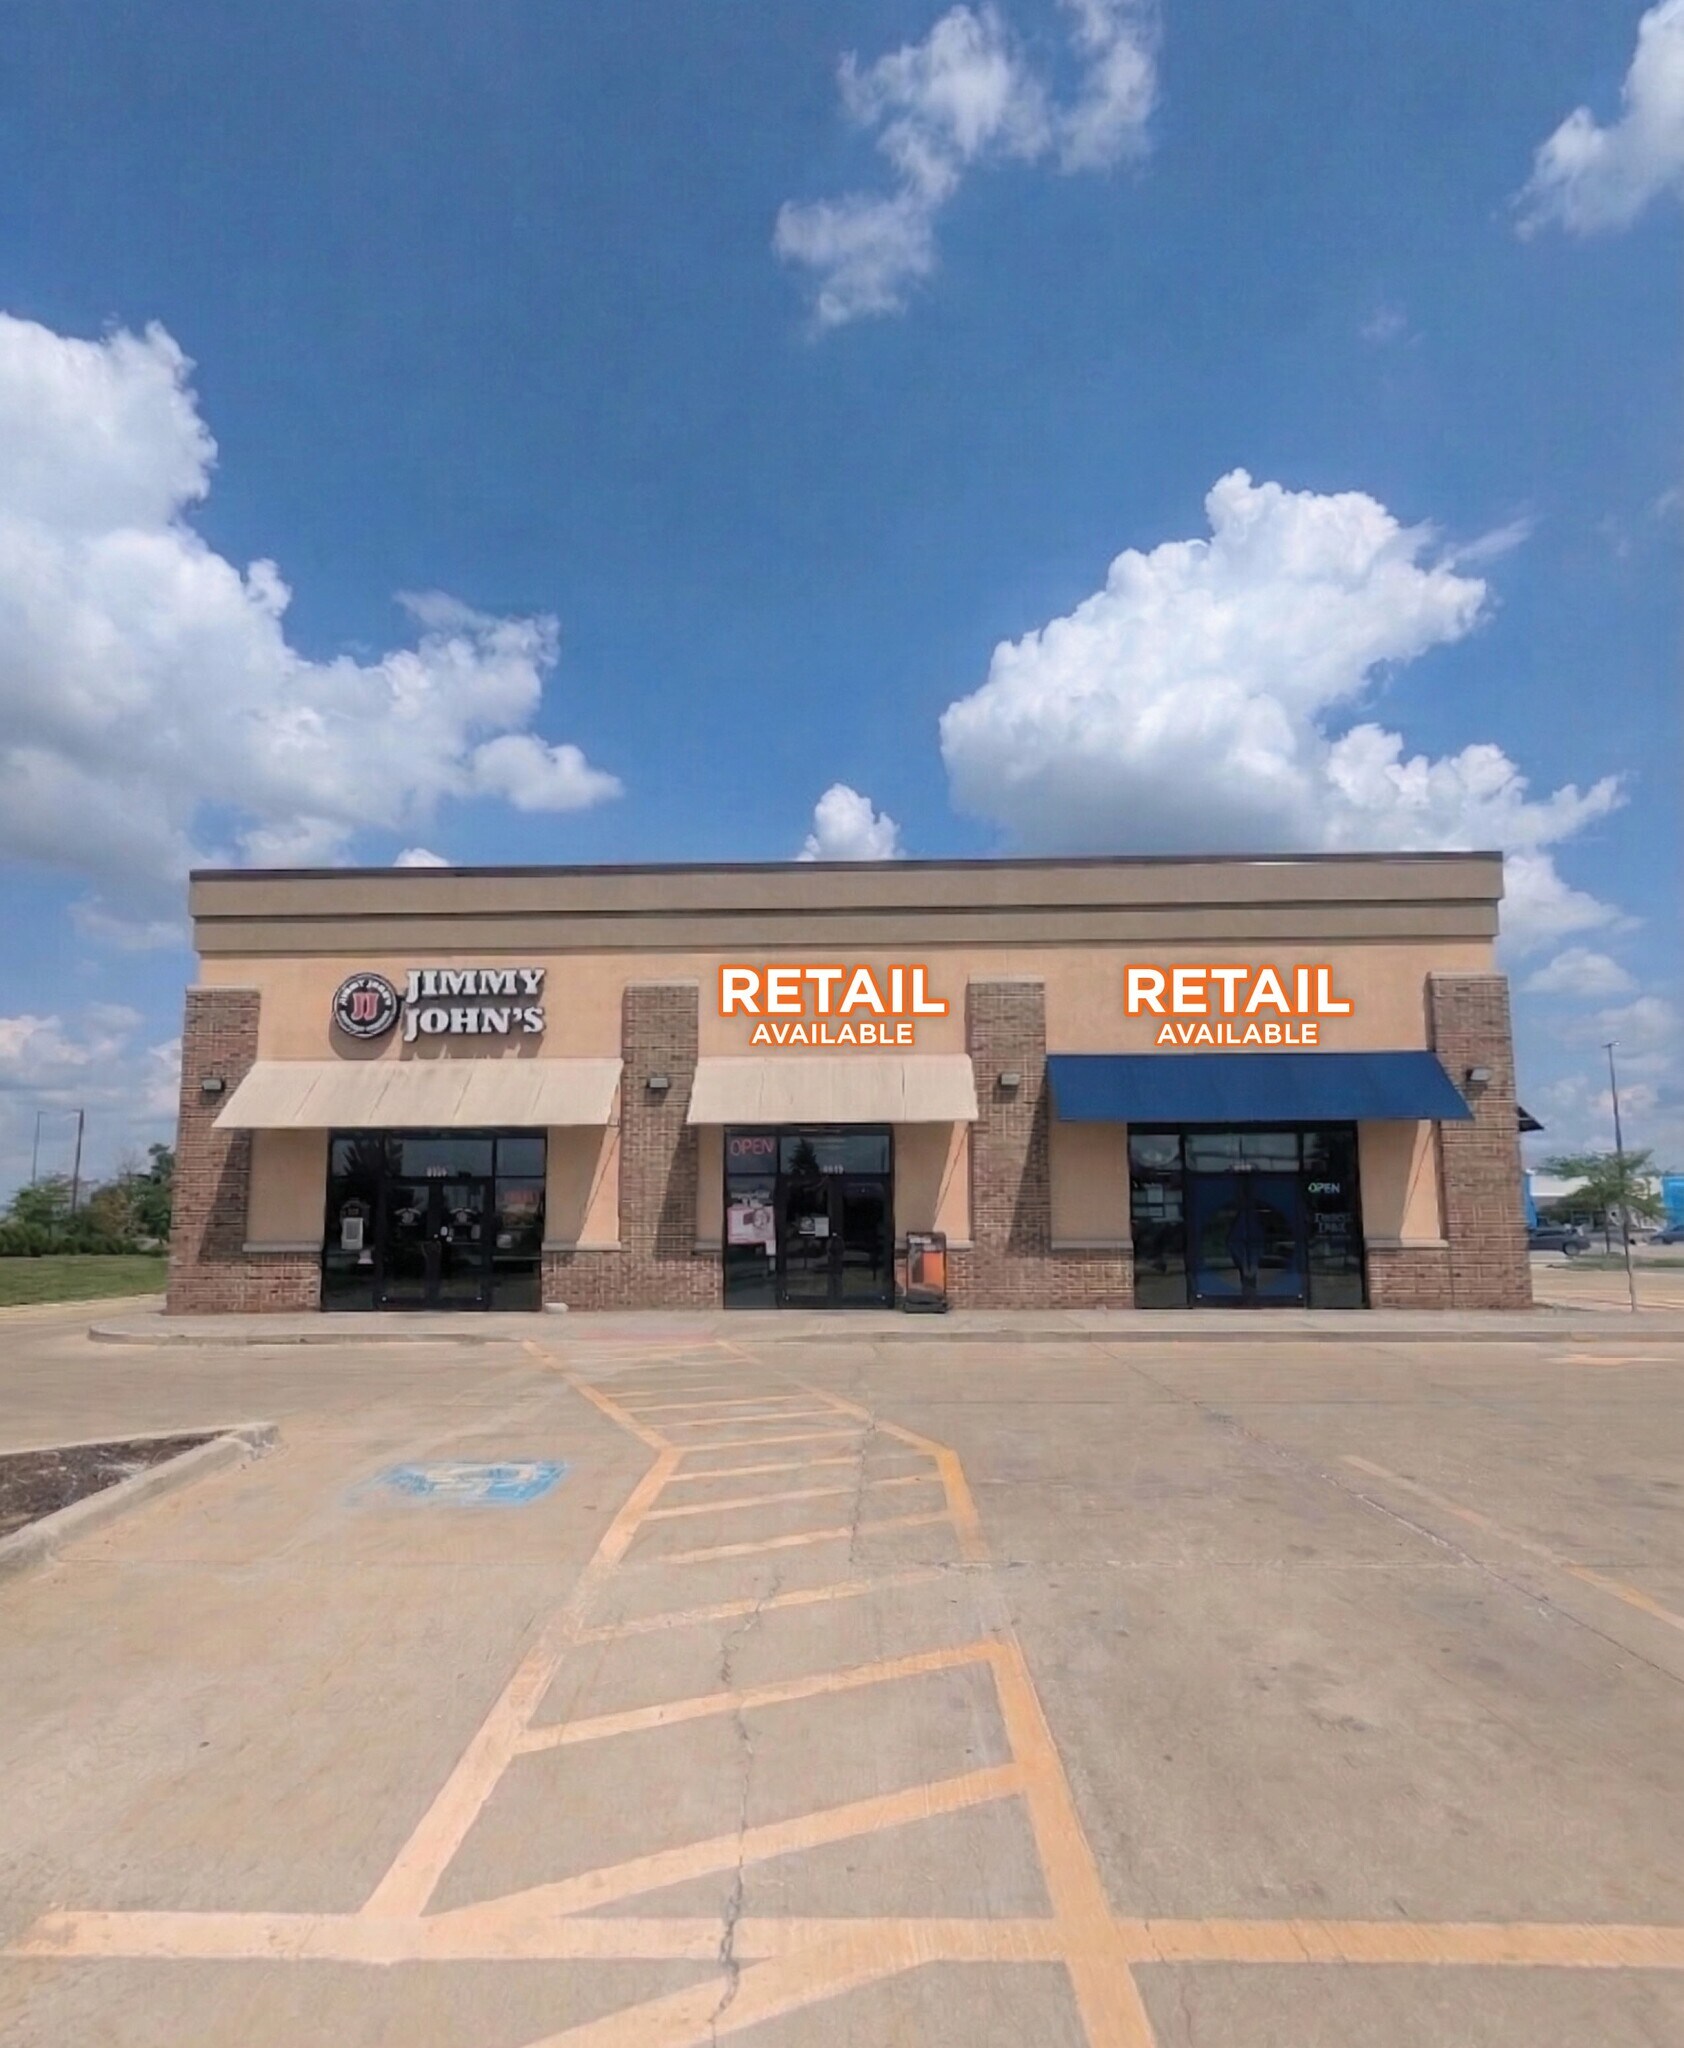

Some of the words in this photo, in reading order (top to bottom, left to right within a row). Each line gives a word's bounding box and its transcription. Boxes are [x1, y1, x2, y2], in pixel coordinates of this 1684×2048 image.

[405, 968, 546, 1003] JIMMY
[403, 1006, 544, 1042] JOHN'S
[729, 1136, 775, 1157] OPEN
[1308, 1181, 1341, 1194] OPEN
